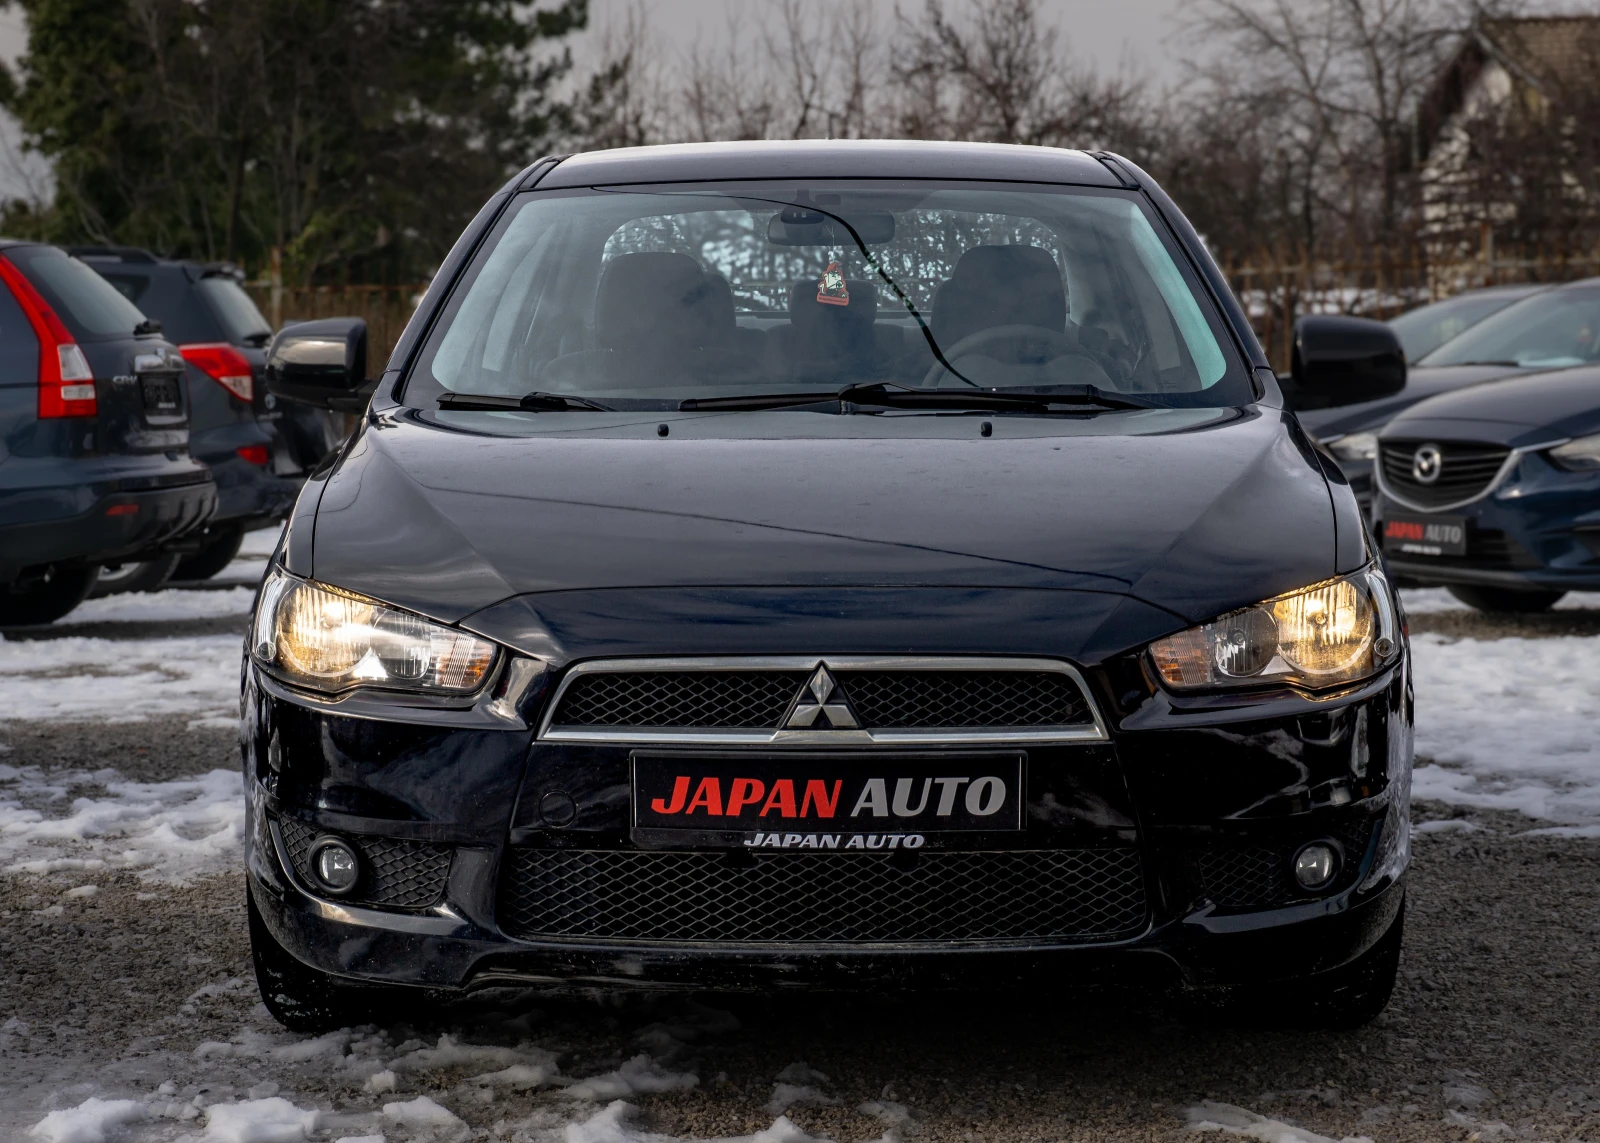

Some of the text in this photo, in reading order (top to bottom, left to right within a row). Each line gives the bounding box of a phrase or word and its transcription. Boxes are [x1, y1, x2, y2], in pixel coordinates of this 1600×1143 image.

[1425, 524, 1462, 544] AUTO
[651, 775, 1006, 819] JAPAN AUTO
[743, 832, 925, 849] JAPAN AUTO
